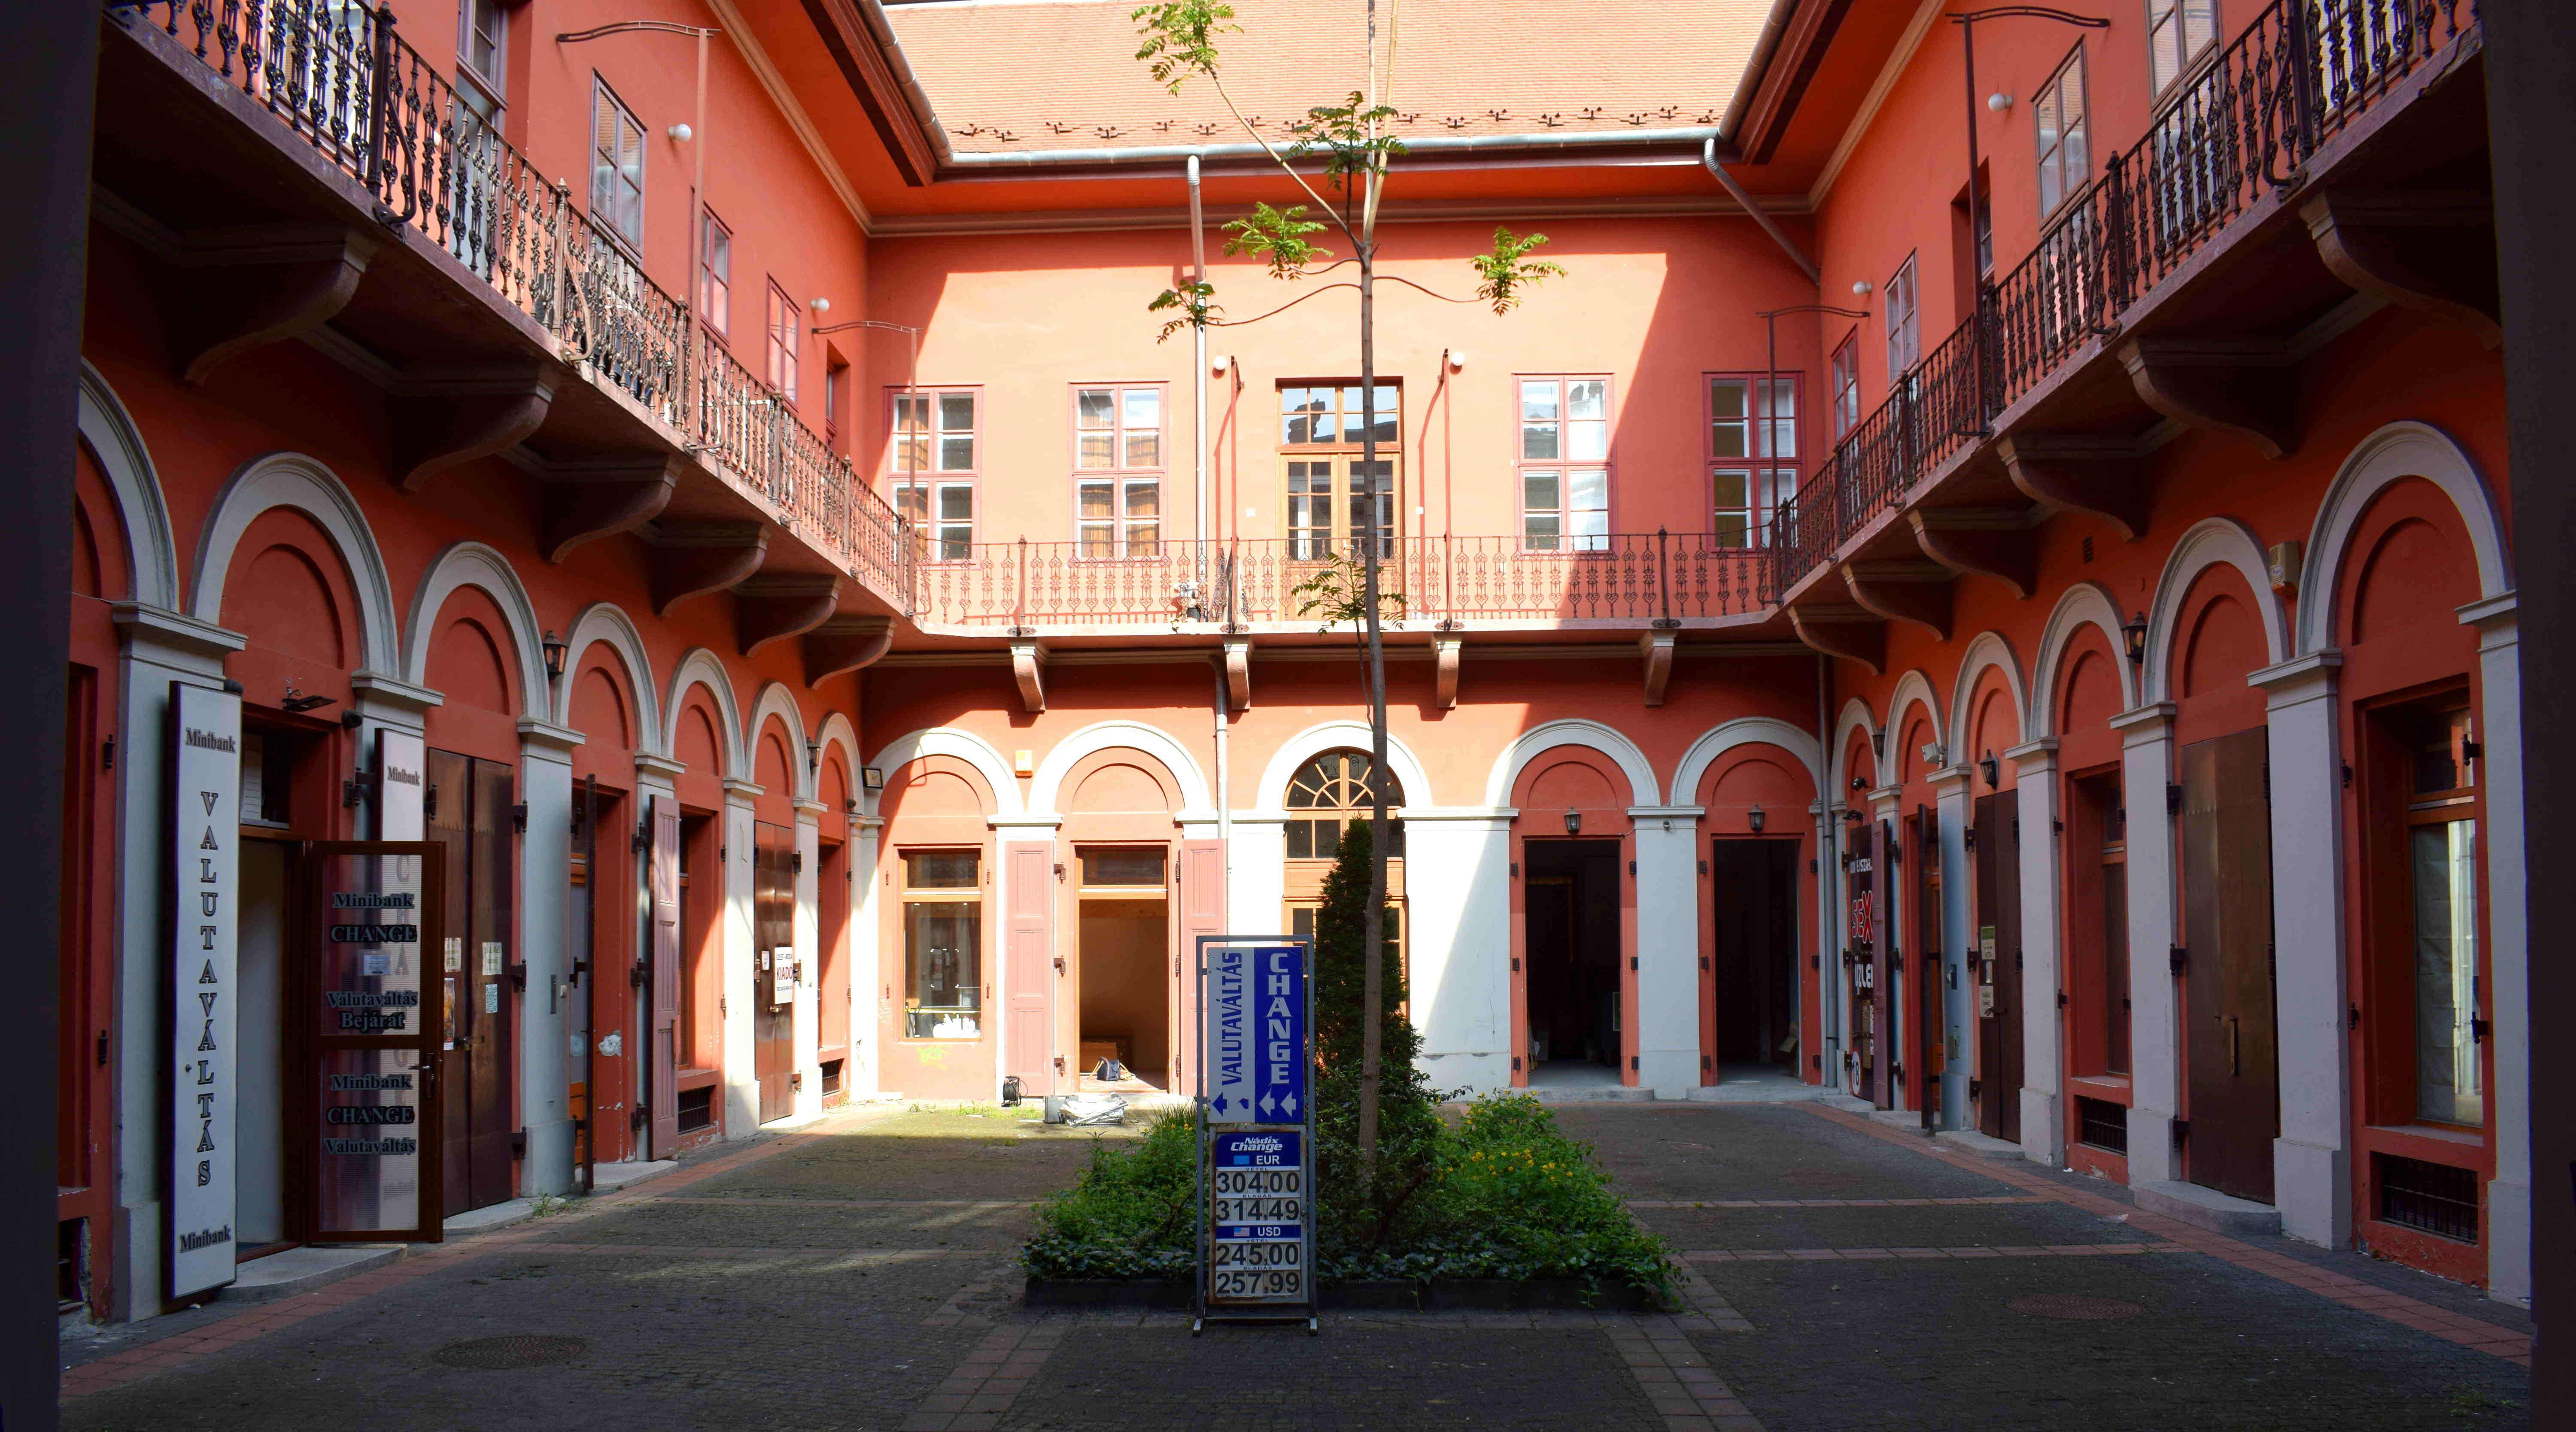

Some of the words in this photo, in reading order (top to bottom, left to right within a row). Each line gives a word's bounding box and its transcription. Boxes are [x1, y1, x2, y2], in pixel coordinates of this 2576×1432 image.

[185, 727, 235, 754] Minibank
[387, 765, 420, 786] Minibank
[333, 893, 415, 909] Minibank
[1852, 890, 1874, 944] SEX
[331, 925, 417, 943] CHANGE
[777, 963, 793, 980] KIADÓ
[197, 791, 219, 1187] VALUTAVÁLTÁS
[327, 990, 418, 1008] Valutaváltás
[339, 1010, 405, 1034] Bejárat
[1216, 952, 1242, 1086] VALUTAVÁLTÁS
[1266, 953, 1292, 1085] CHANGE
[331, 1074, 413, 1090] Minibank
[327, 1106, 415, 1125] CHANGE
[324, 1137, 416, 1155] Valutaváltás
[1230, 1142, 1283, 1153] Change
[1245, 1136, 1279, 1144] Nádix
[1256, 1155, 1280, 1165] EUR
[1216, 1172, 1299, 1193] 304,00
[1215, 1199, 1299, 1221] 314,49
[179, 1224, 232, 1254] Minibank
[1258, 1227, 1281, 1236] USD
[1216, 1244, 1299, 1265] 245,00
[1216, 1272, 1300, 1294] 257,99
